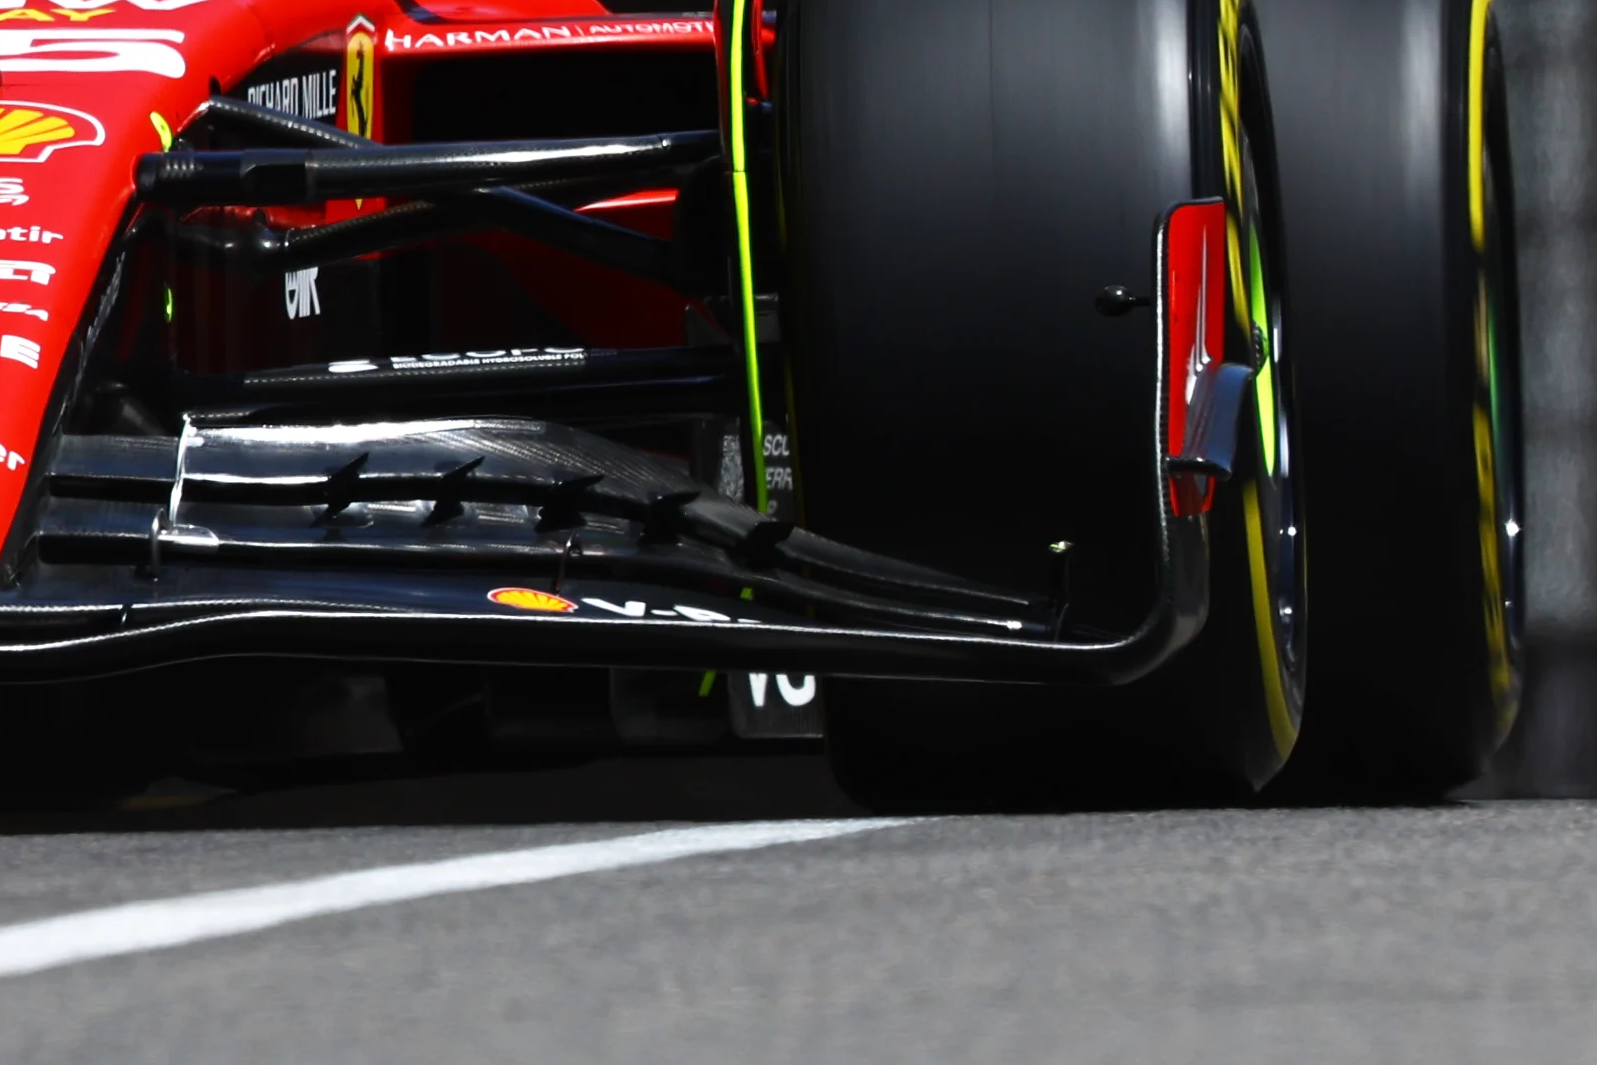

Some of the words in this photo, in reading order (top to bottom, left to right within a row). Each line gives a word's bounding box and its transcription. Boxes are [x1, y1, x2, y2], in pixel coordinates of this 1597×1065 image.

[385, 25, 571, 52] HARMAN
[589, 20, 715, 36] AUTOMOTI
[302, 69, 337, 119] MILLE
